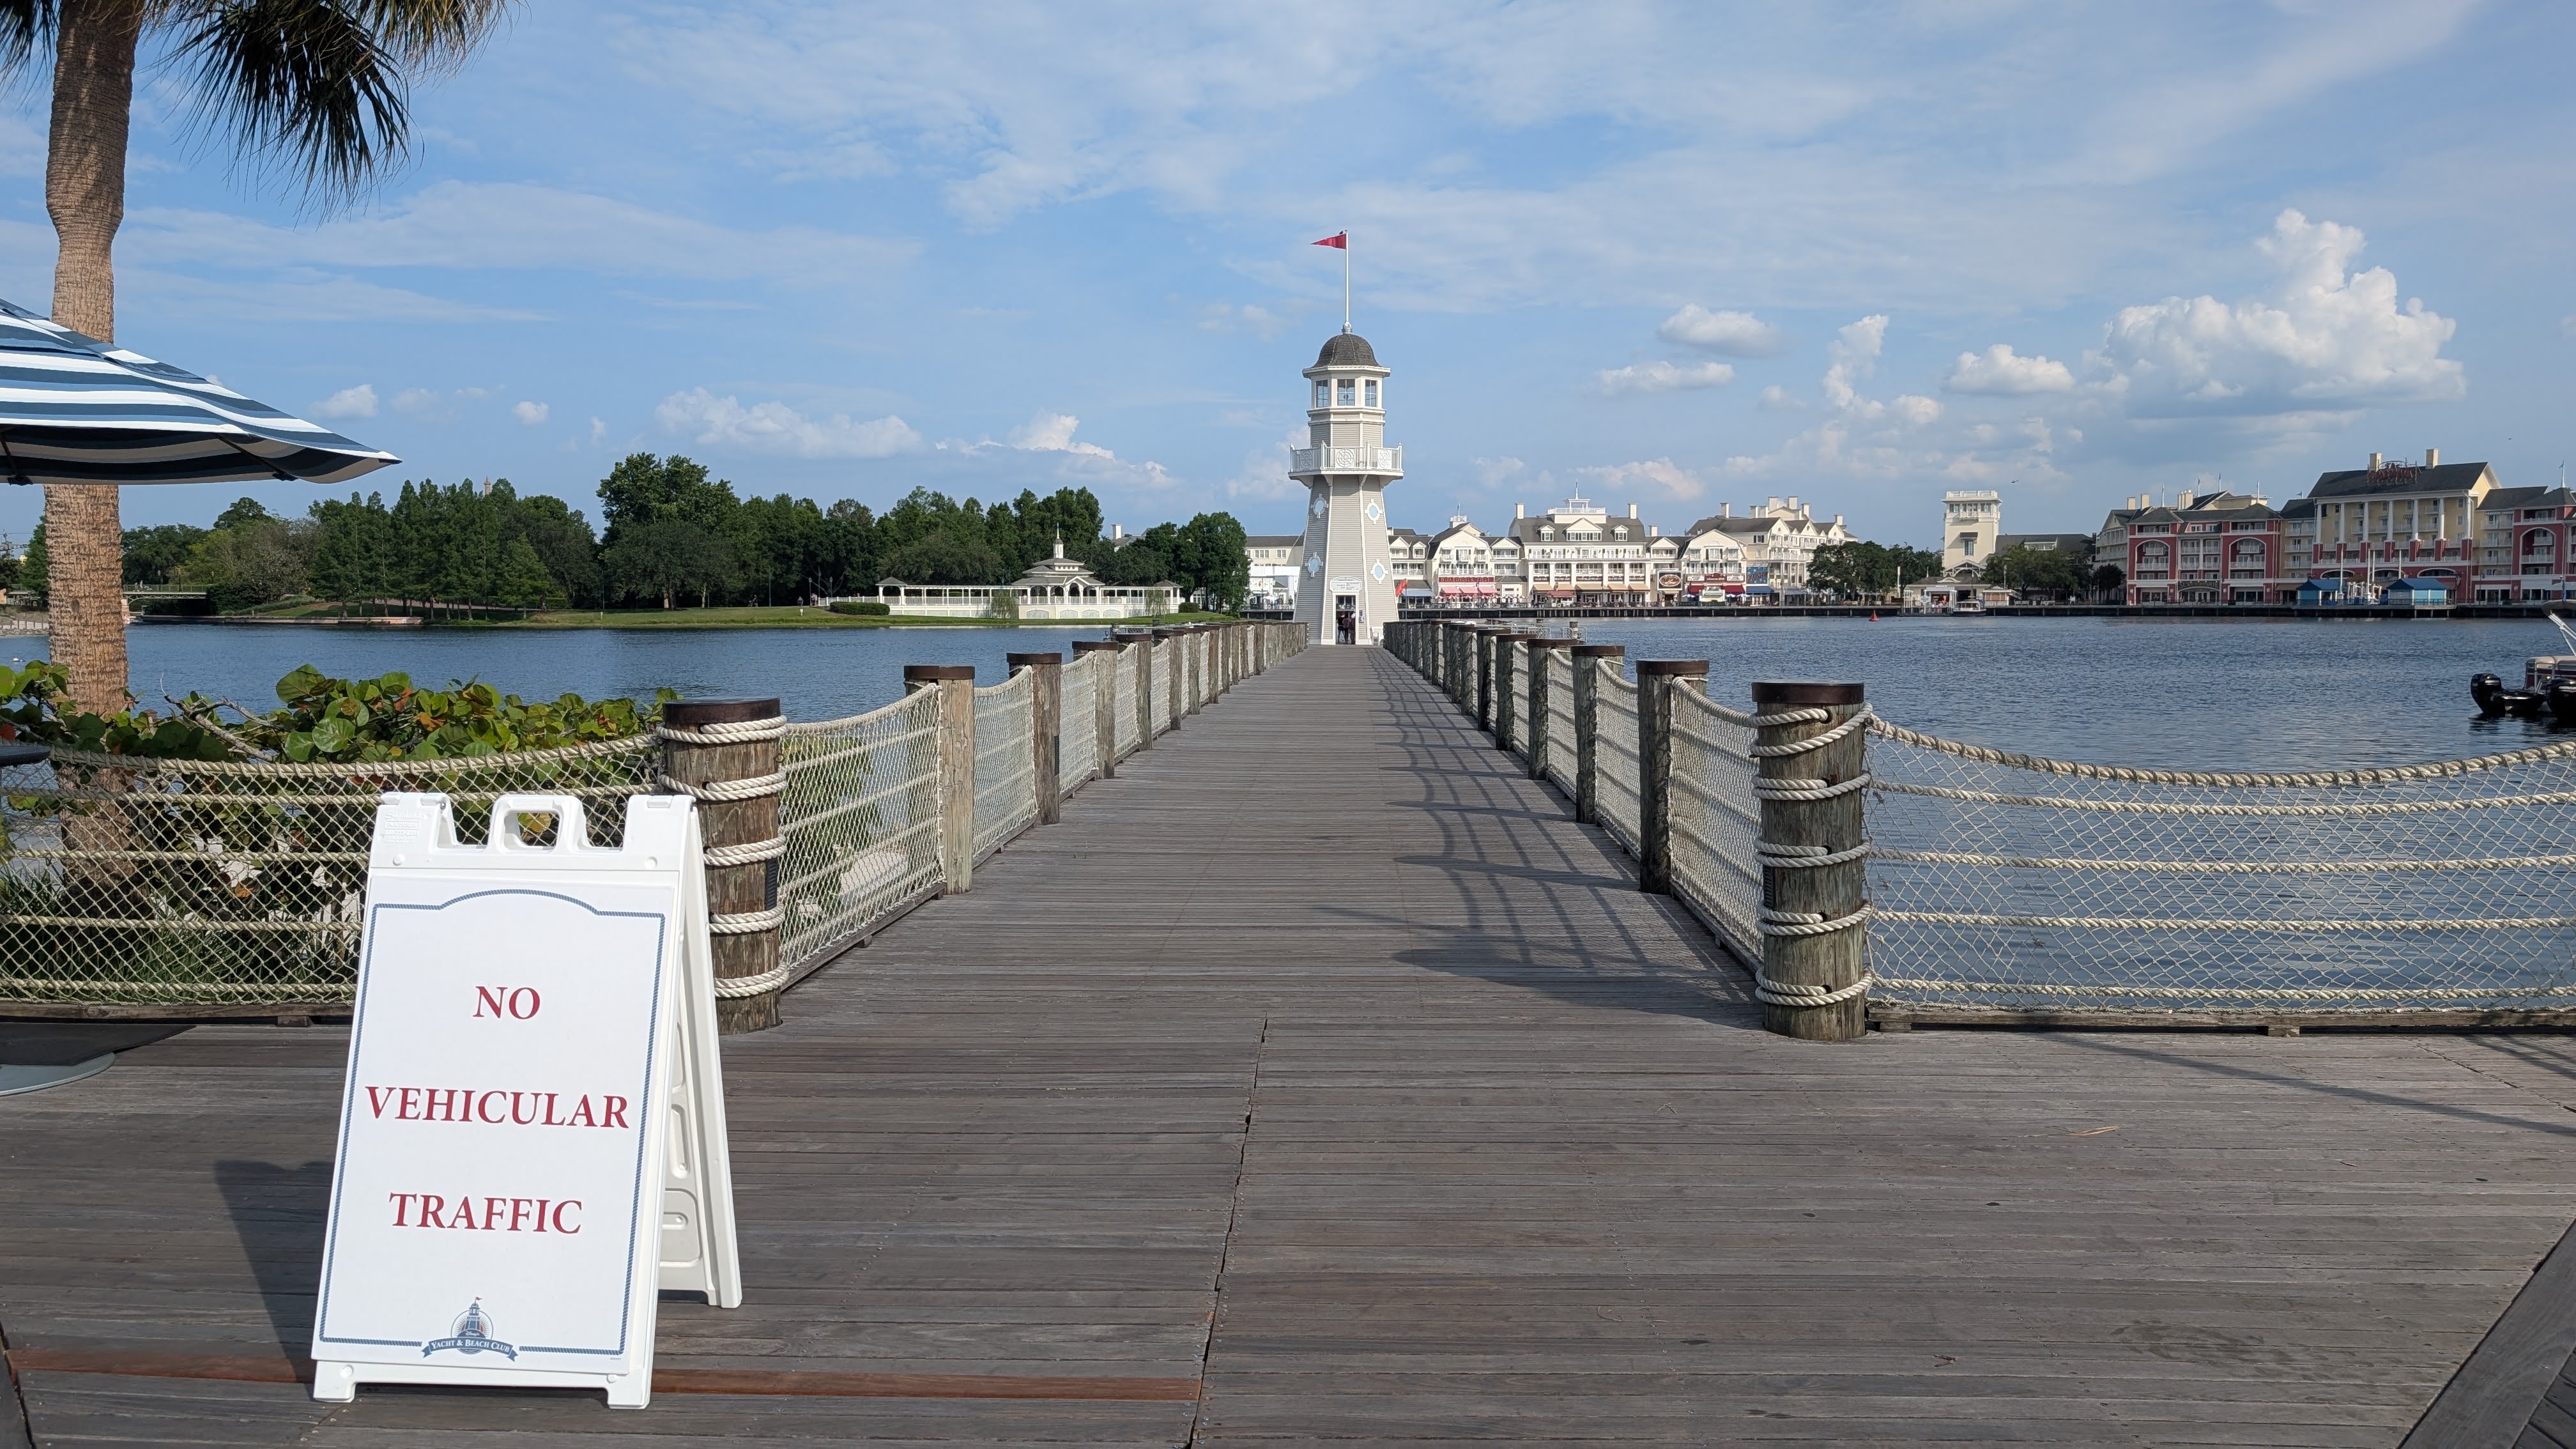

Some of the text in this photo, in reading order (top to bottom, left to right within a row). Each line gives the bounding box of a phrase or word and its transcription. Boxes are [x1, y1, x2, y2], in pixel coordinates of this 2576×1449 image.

[473, 986, 541, 1020] NO
[365, 1086, 629, 1129] VEHICULAR
[389, 1192, 582, 1234] TRAFFIC
[431, 1340, 456, 1349] YACHT
[465, 1339, 490, 1347] BEACH
[491, 1342, 510, 1353] CLUB
